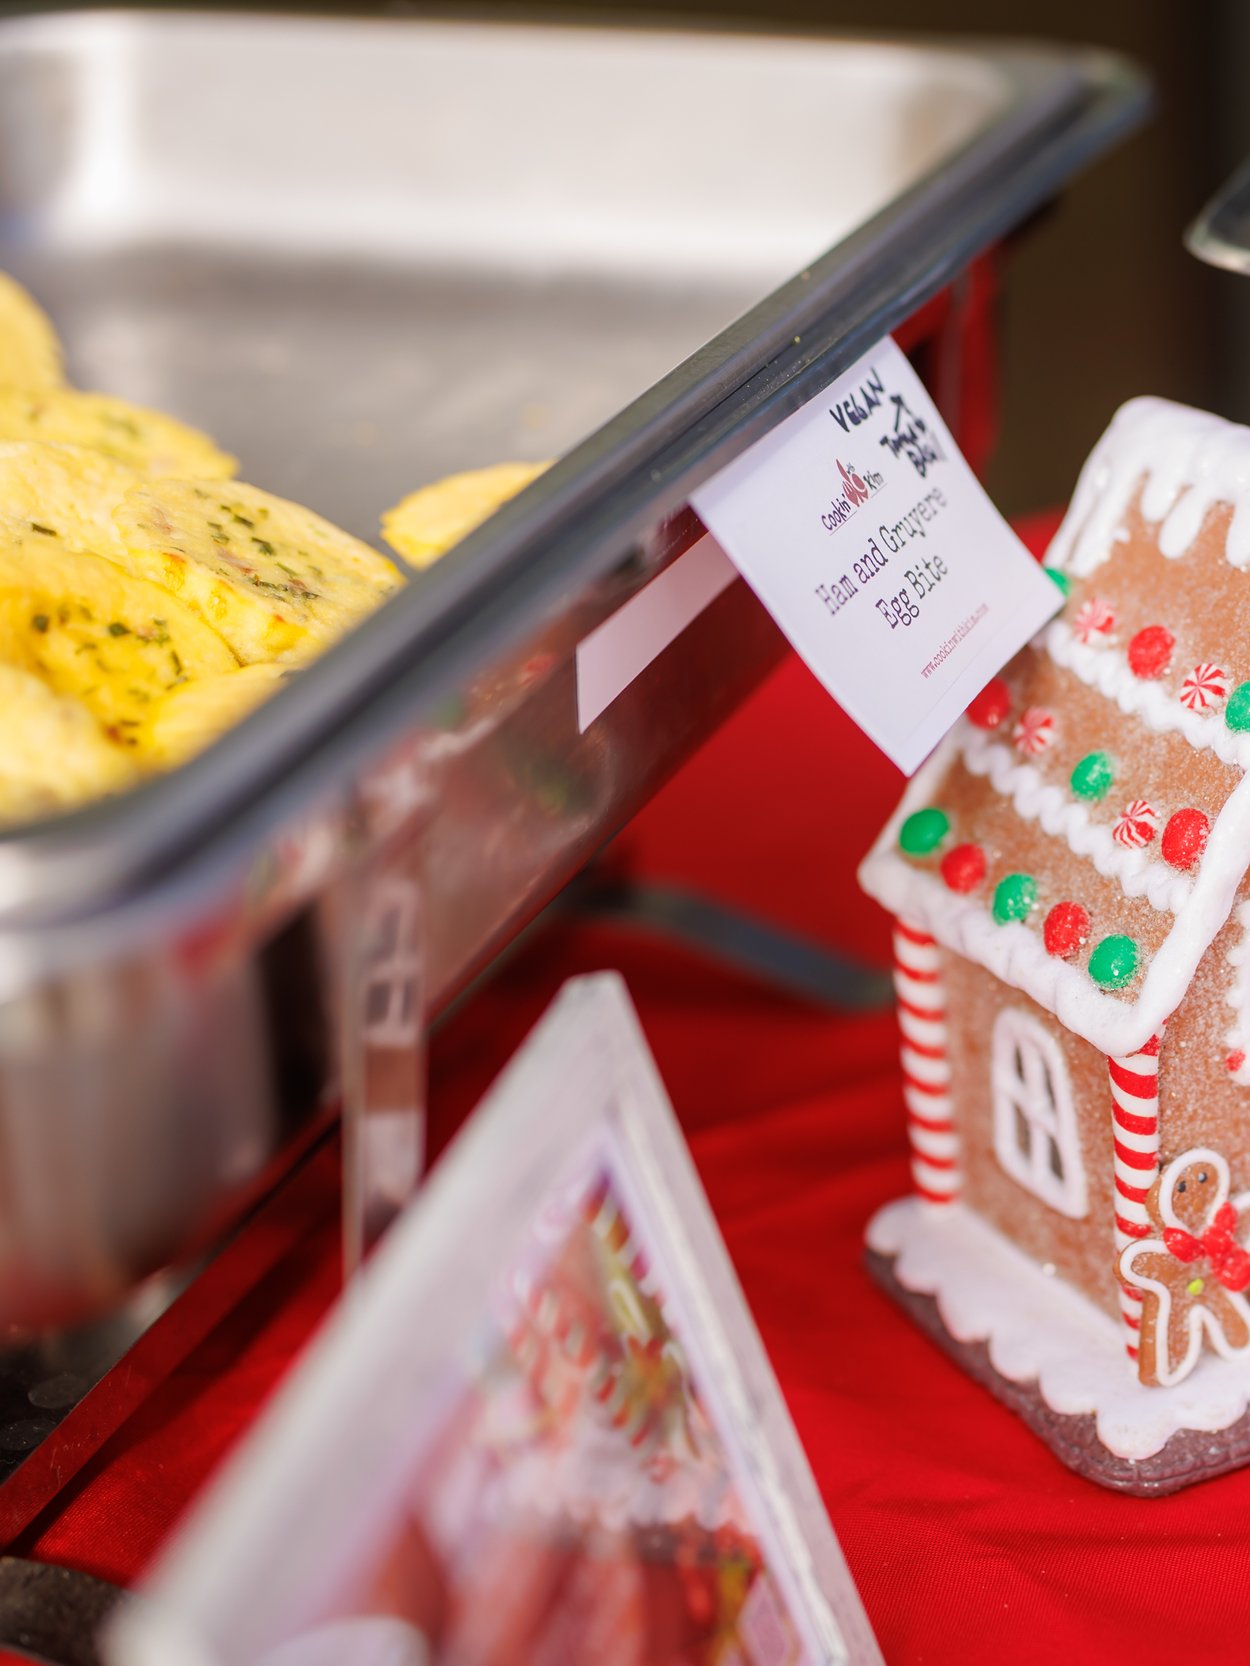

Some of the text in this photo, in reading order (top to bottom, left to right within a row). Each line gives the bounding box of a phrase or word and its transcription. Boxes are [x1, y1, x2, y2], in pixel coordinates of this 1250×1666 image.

[829, 366, 884, 433] VEGAN
[863, 470, 885, 490] Kim
[814, 487, 948, 616] Ham and Gruyere
[875, 555, 949, 630] Egg Bite
